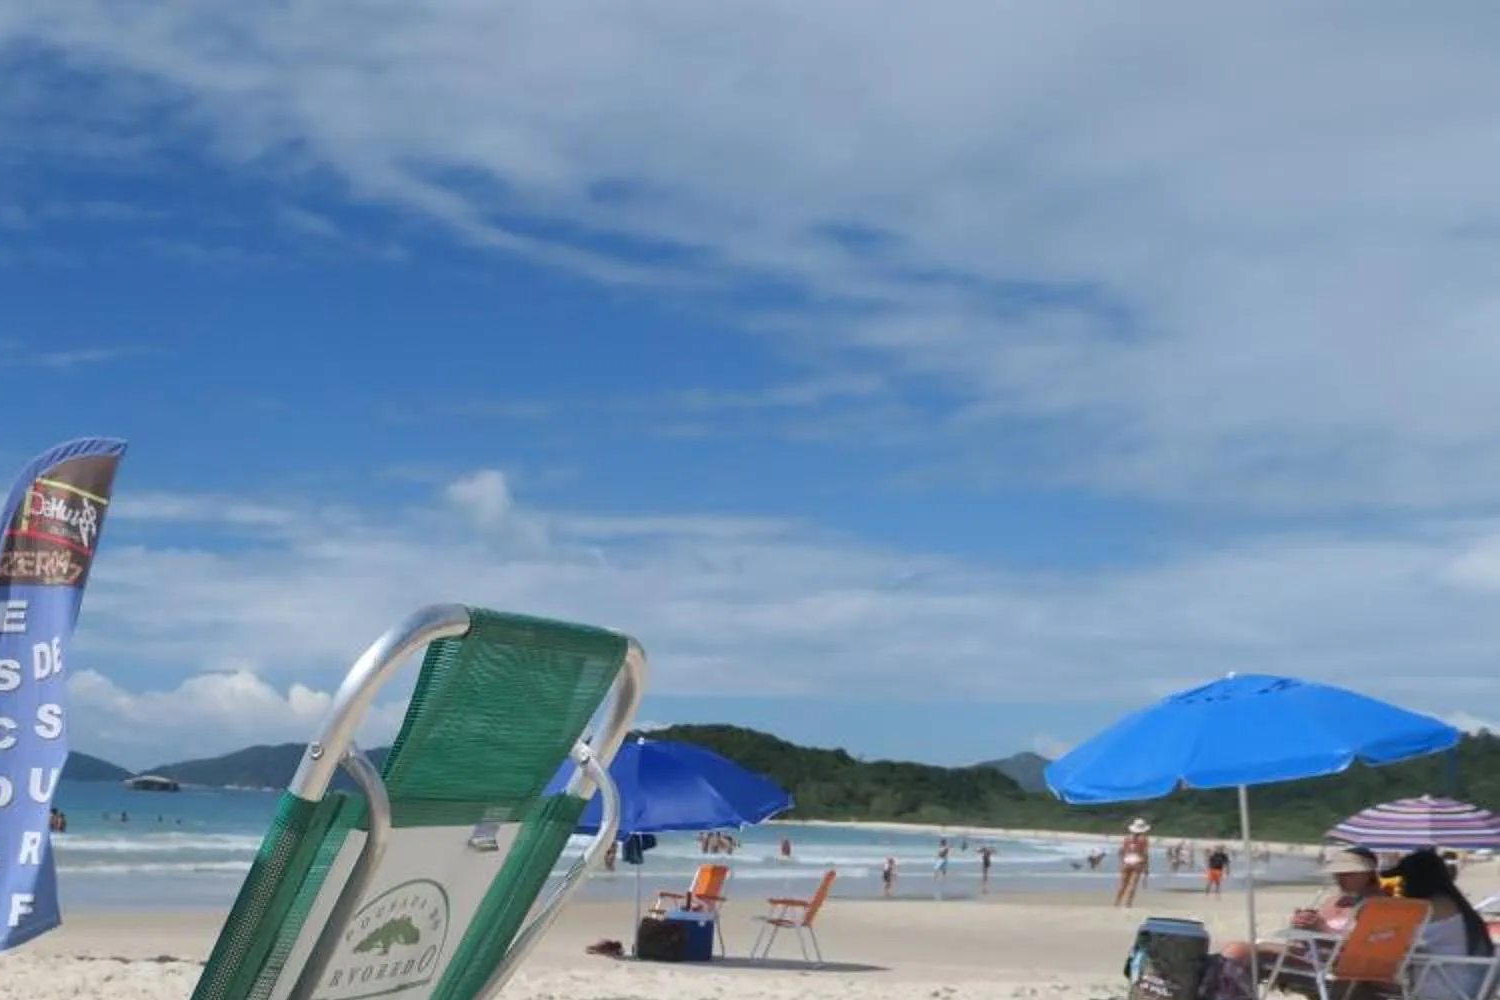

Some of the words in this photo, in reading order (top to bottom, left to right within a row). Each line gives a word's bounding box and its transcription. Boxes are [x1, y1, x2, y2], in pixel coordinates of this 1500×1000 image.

[33, 637, 63, 681] DE
[7, 703, 63, 927] SURF
[328, 945, 437, 988] RVOREDO
